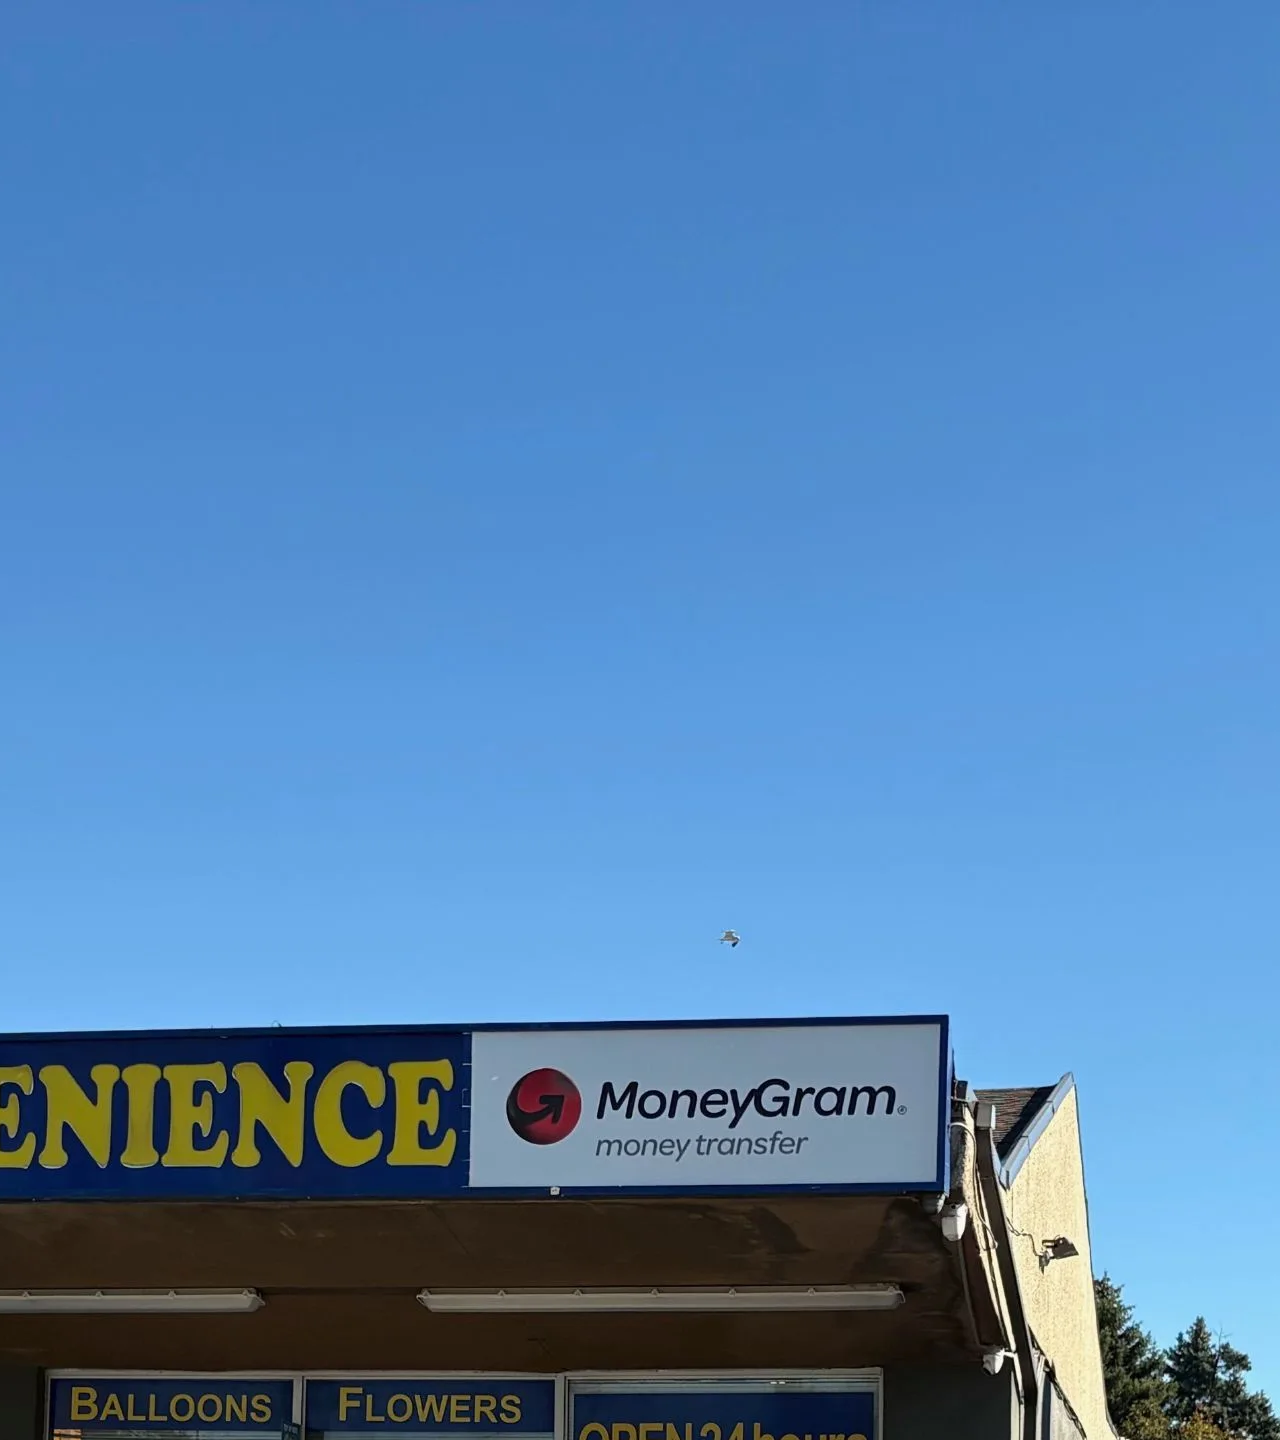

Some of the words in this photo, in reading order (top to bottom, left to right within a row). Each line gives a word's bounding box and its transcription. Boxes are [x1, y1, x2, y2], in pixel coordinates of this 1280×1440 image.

[596, 1137, 690, 1162] money
[695, 1131, 808, 1156] transfer
[70, 1386, 272, 1422] BALLOONS
[338, 1387, 522, 1424] FLOWERS
